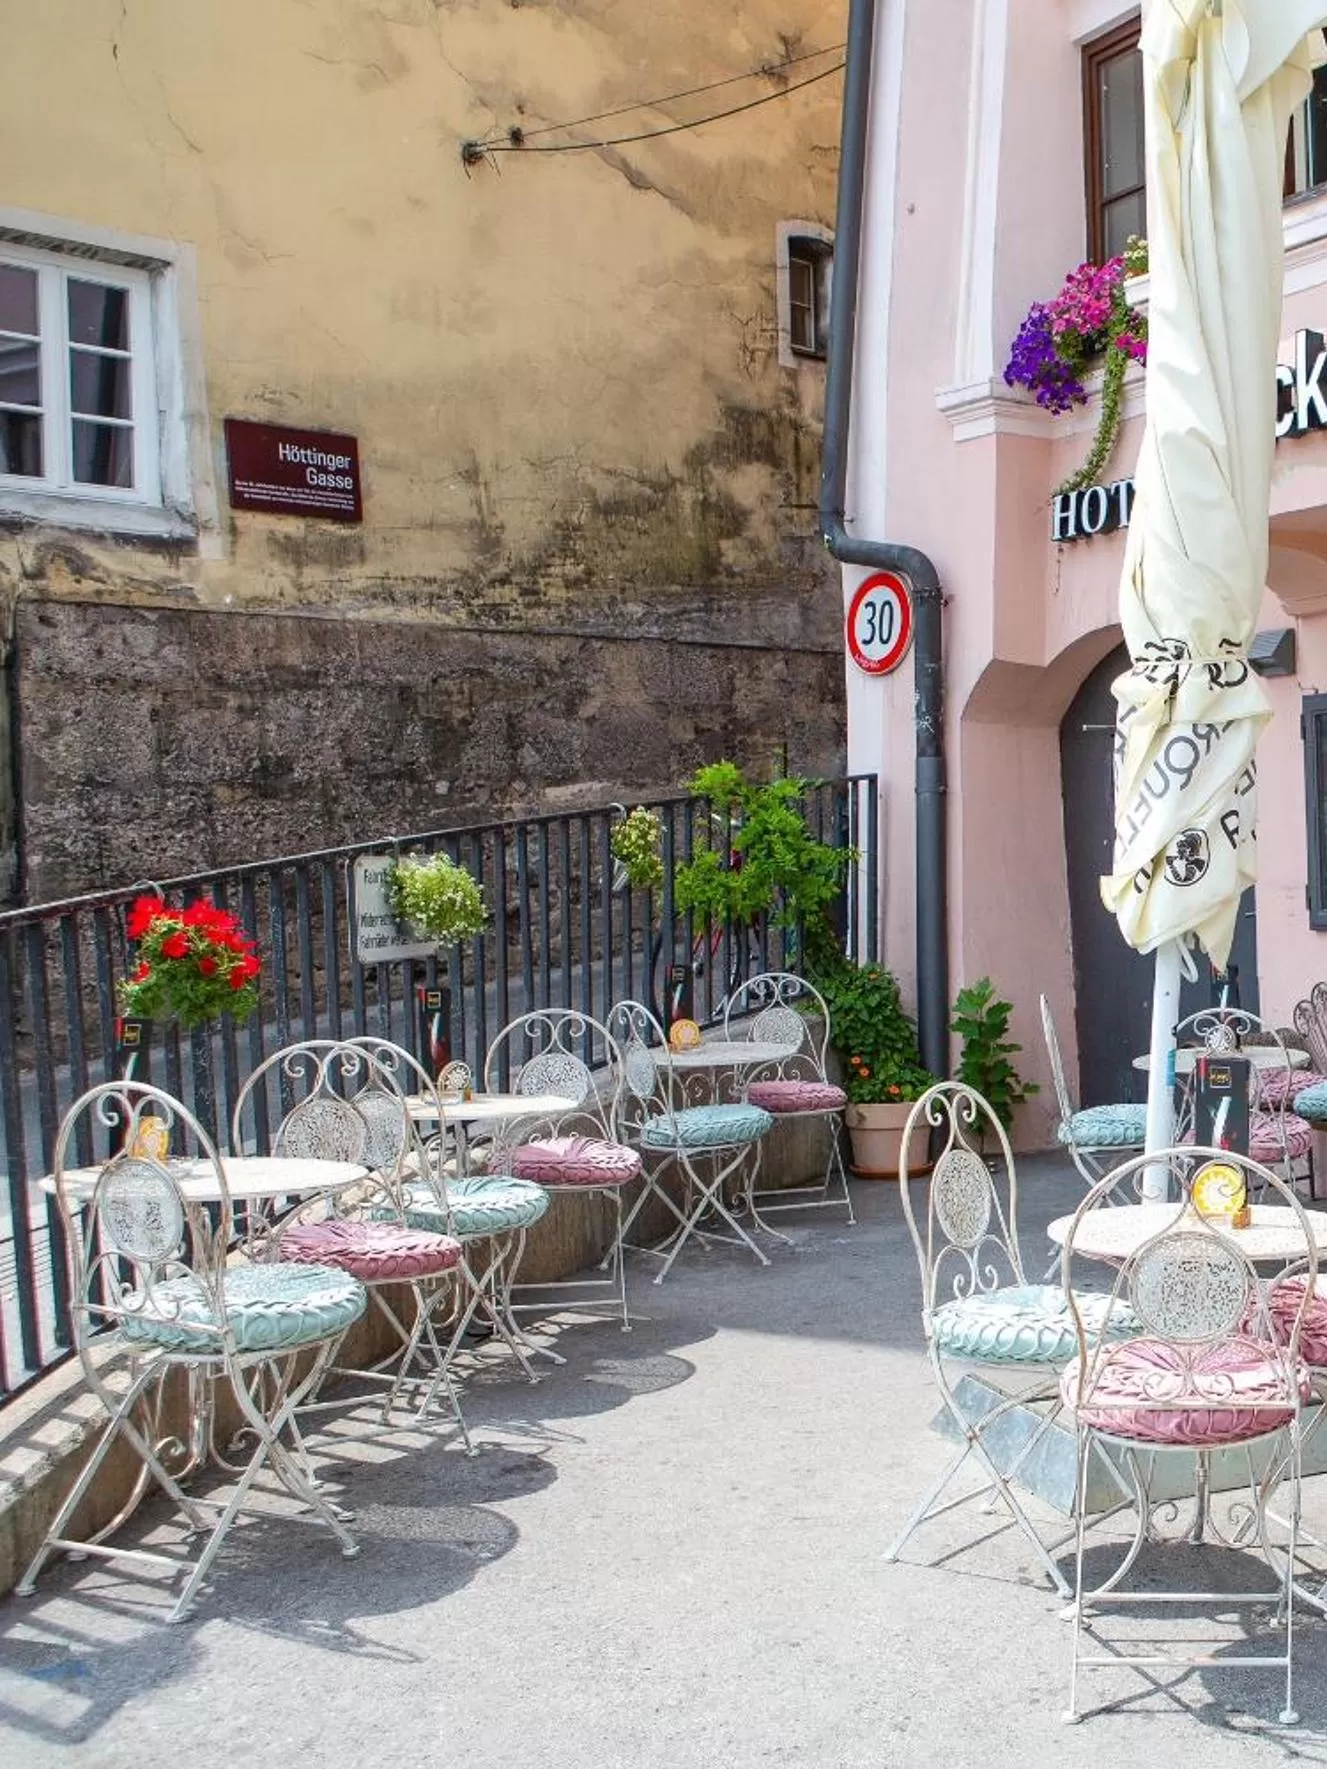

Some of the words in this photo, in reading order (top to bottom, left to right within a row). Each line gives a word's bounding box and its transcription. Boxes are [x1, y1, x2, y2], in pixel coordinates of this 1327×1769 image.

[278, 441, 351, 471] Höttinger
[306, 468, 353, 490] Gasse
[861, 600, 894, 645] 30
